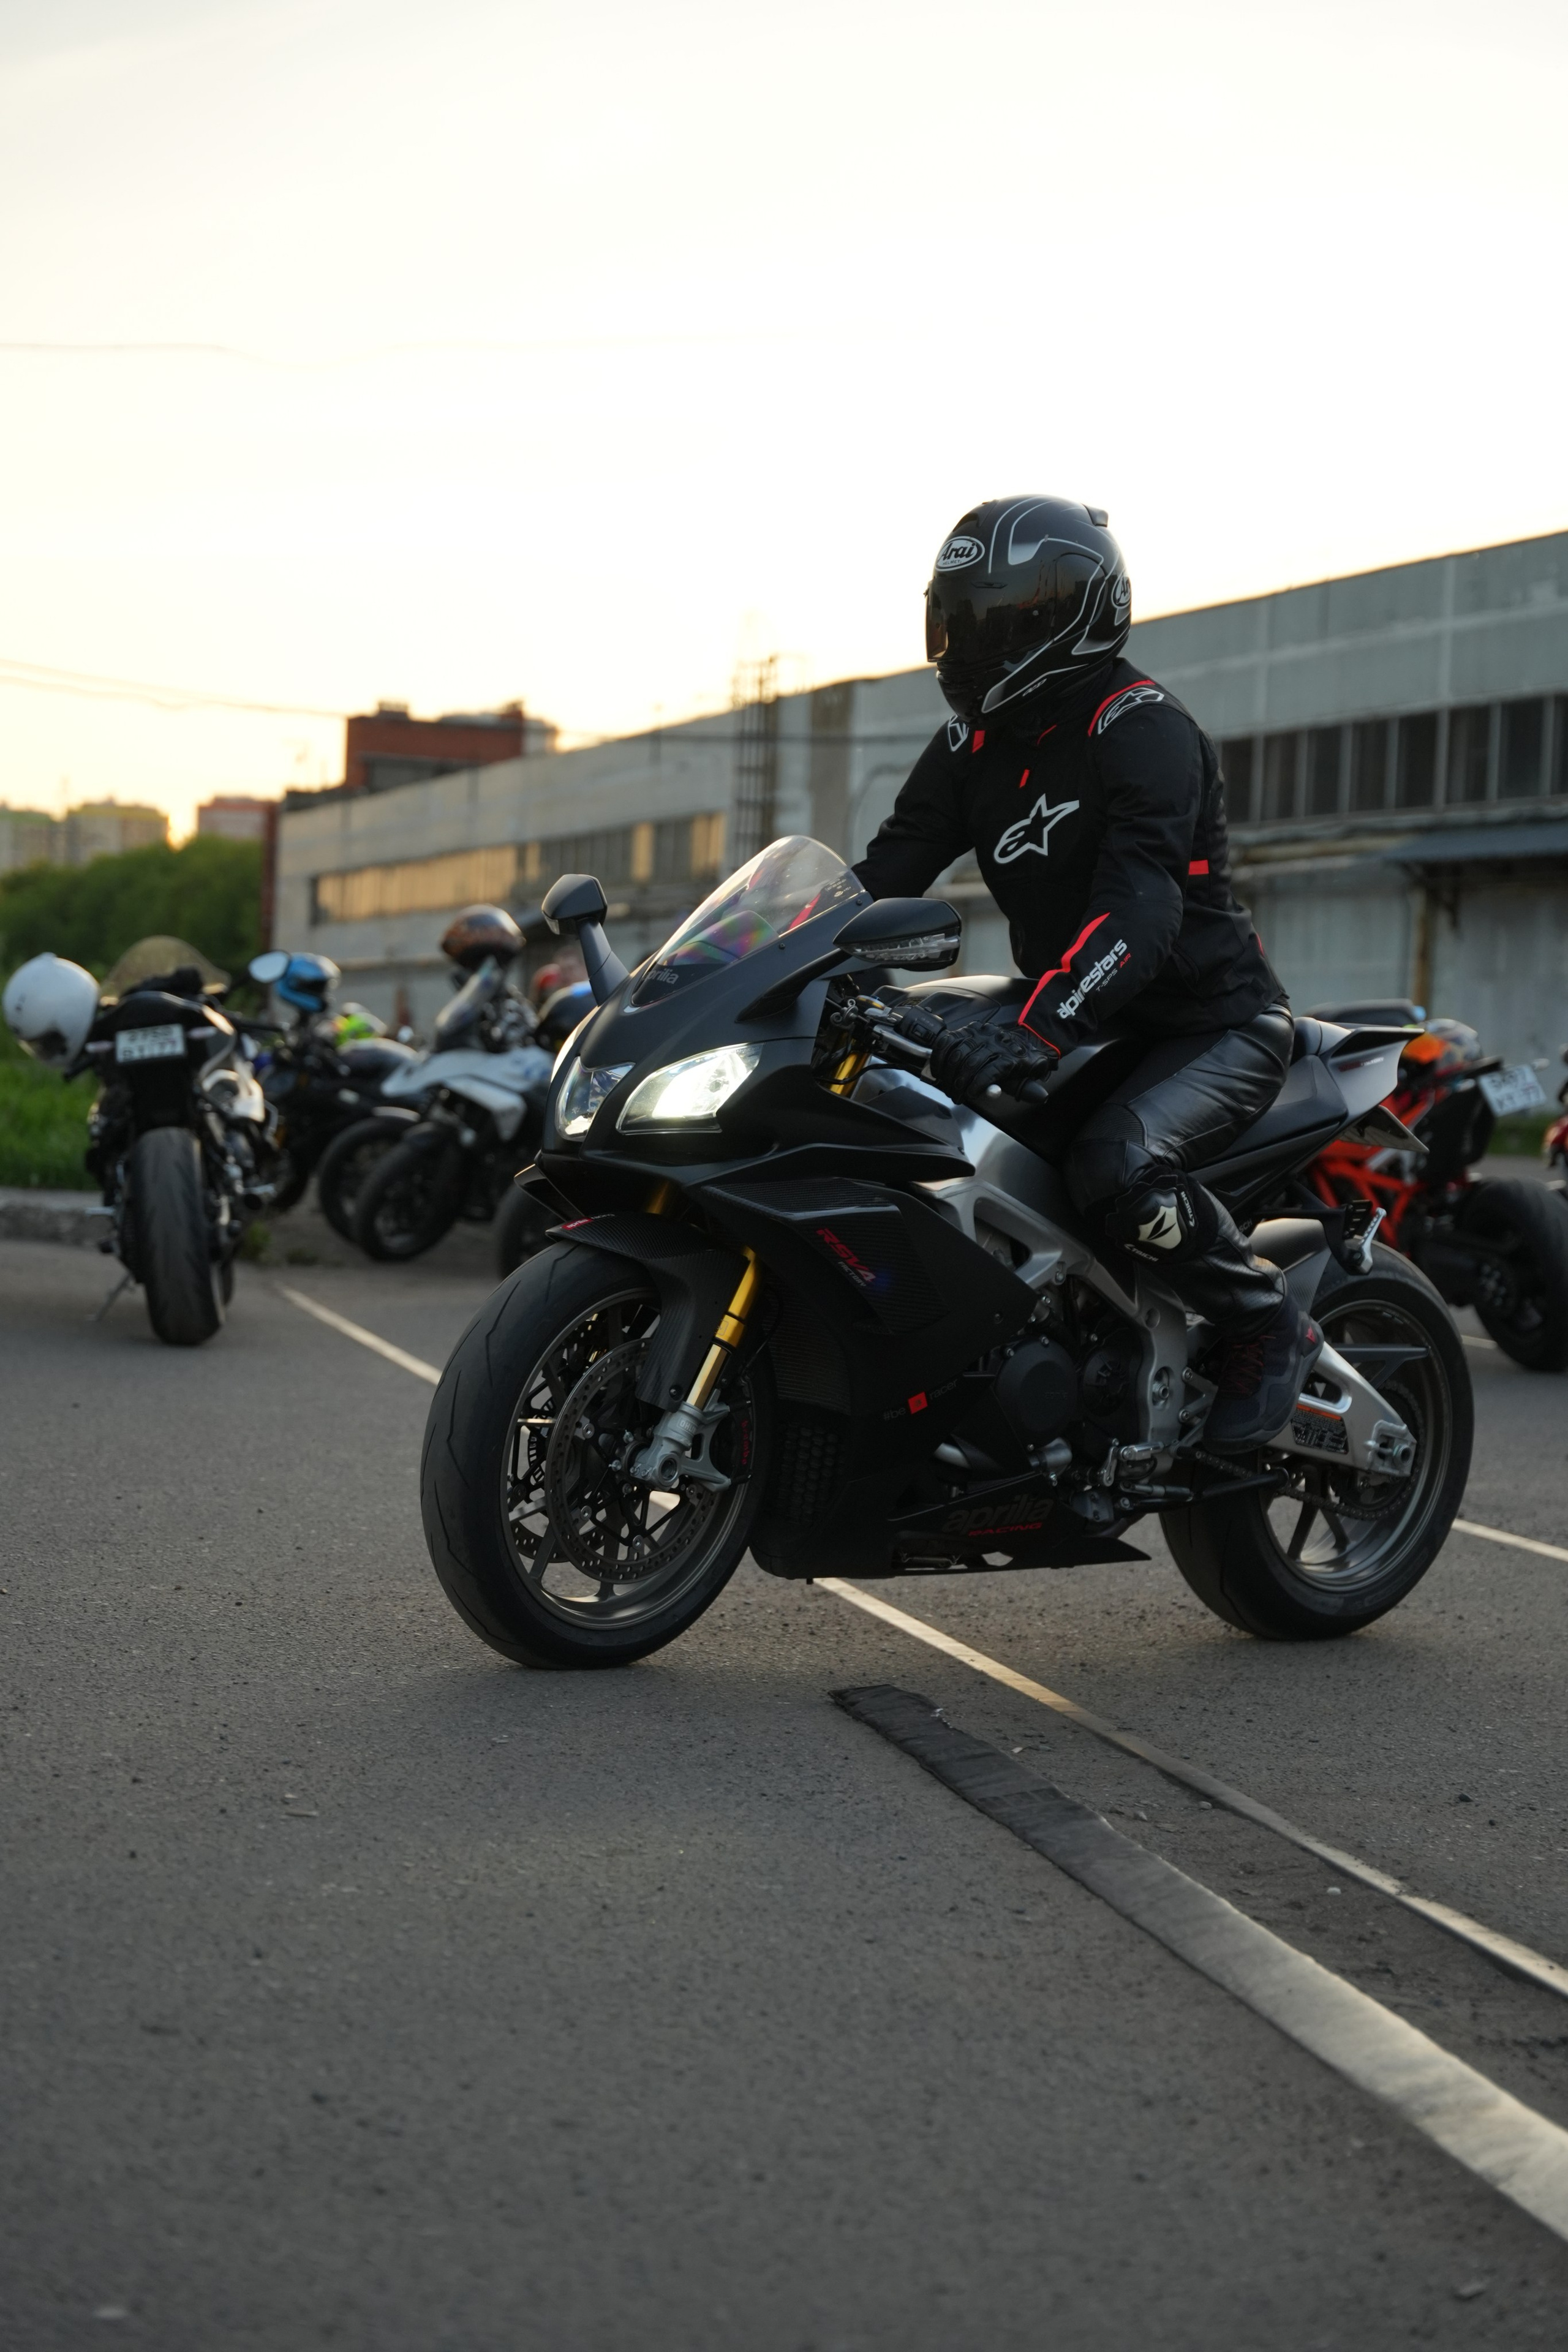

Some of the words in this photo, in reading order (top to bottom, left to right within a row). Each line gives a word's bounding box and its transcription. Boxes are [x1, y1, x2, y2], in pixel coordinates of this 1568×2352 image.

[938, 542, 977, 561] Arai
[647, 968, 679, 984] prilia
[1096, 968, 1118, 992] T-SPS
[1120, 952, 1131, 968] AIR
[815, 1227, 876, 1282] RSV4
[837, 1261, 867, 1287] FACTORY
[929, 1379, 957, 1400] racer
[942, 1494, 1054, 1536] aprilia
[968, 1521, 1042, 1537] RACING
